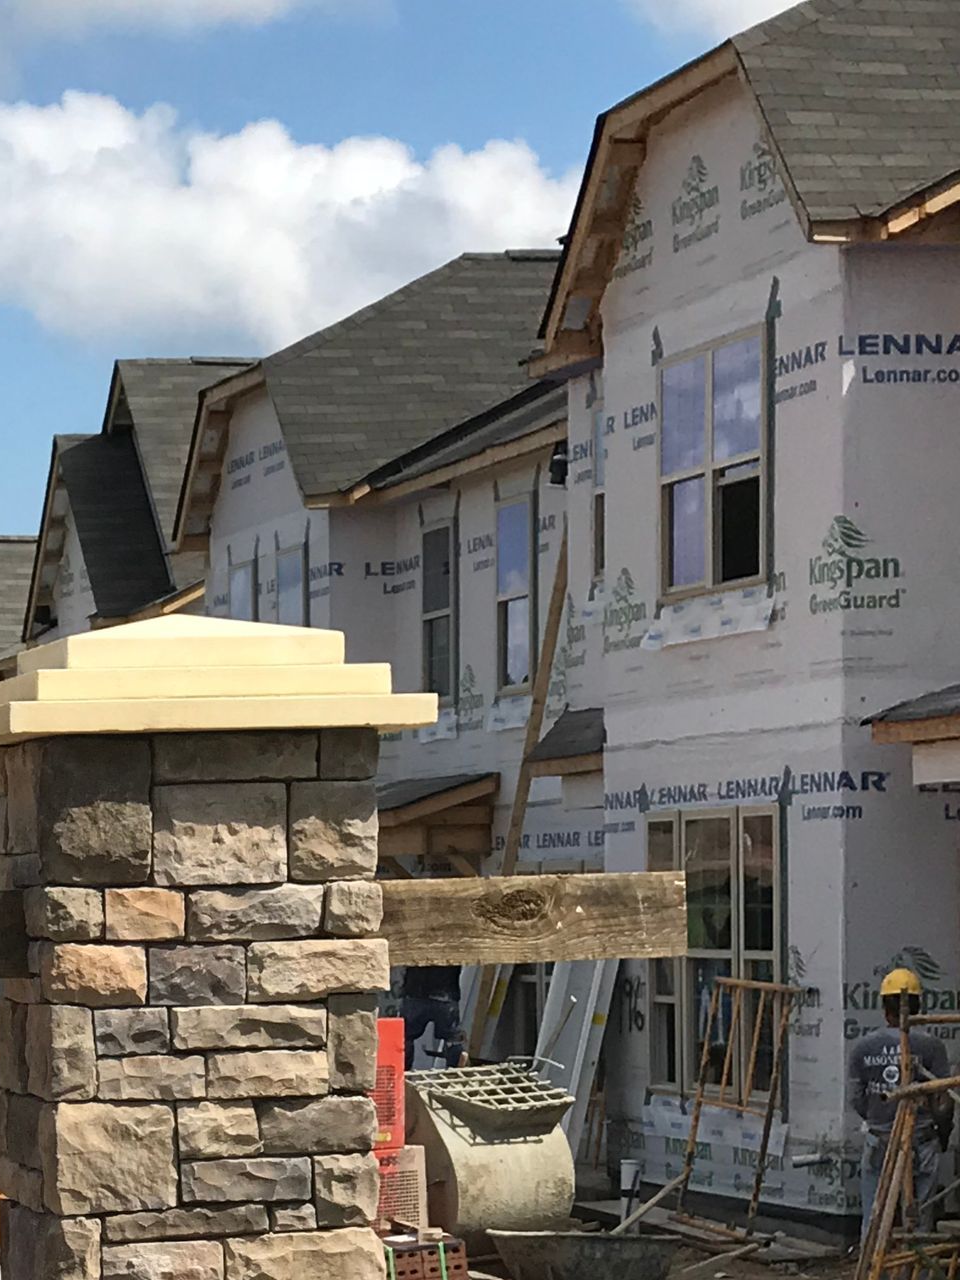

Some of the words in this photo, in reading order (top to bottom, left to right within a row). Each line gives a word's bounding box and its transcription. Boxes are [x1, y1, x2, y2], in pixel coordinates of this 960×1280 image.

[539, 514, 557, 531] AR
[365, 554, 421, 579] LENNAR
[809, 555, 901, 590] Kingspan
[809, 588, 901, 615] GreenGuard
[649, 782, 709, 806] LENNAR
[717, 775, 781, 800] LENNAR
[791, 770, 887, 797] LENNAR
[536, 831, 581, 849] LENNAR
